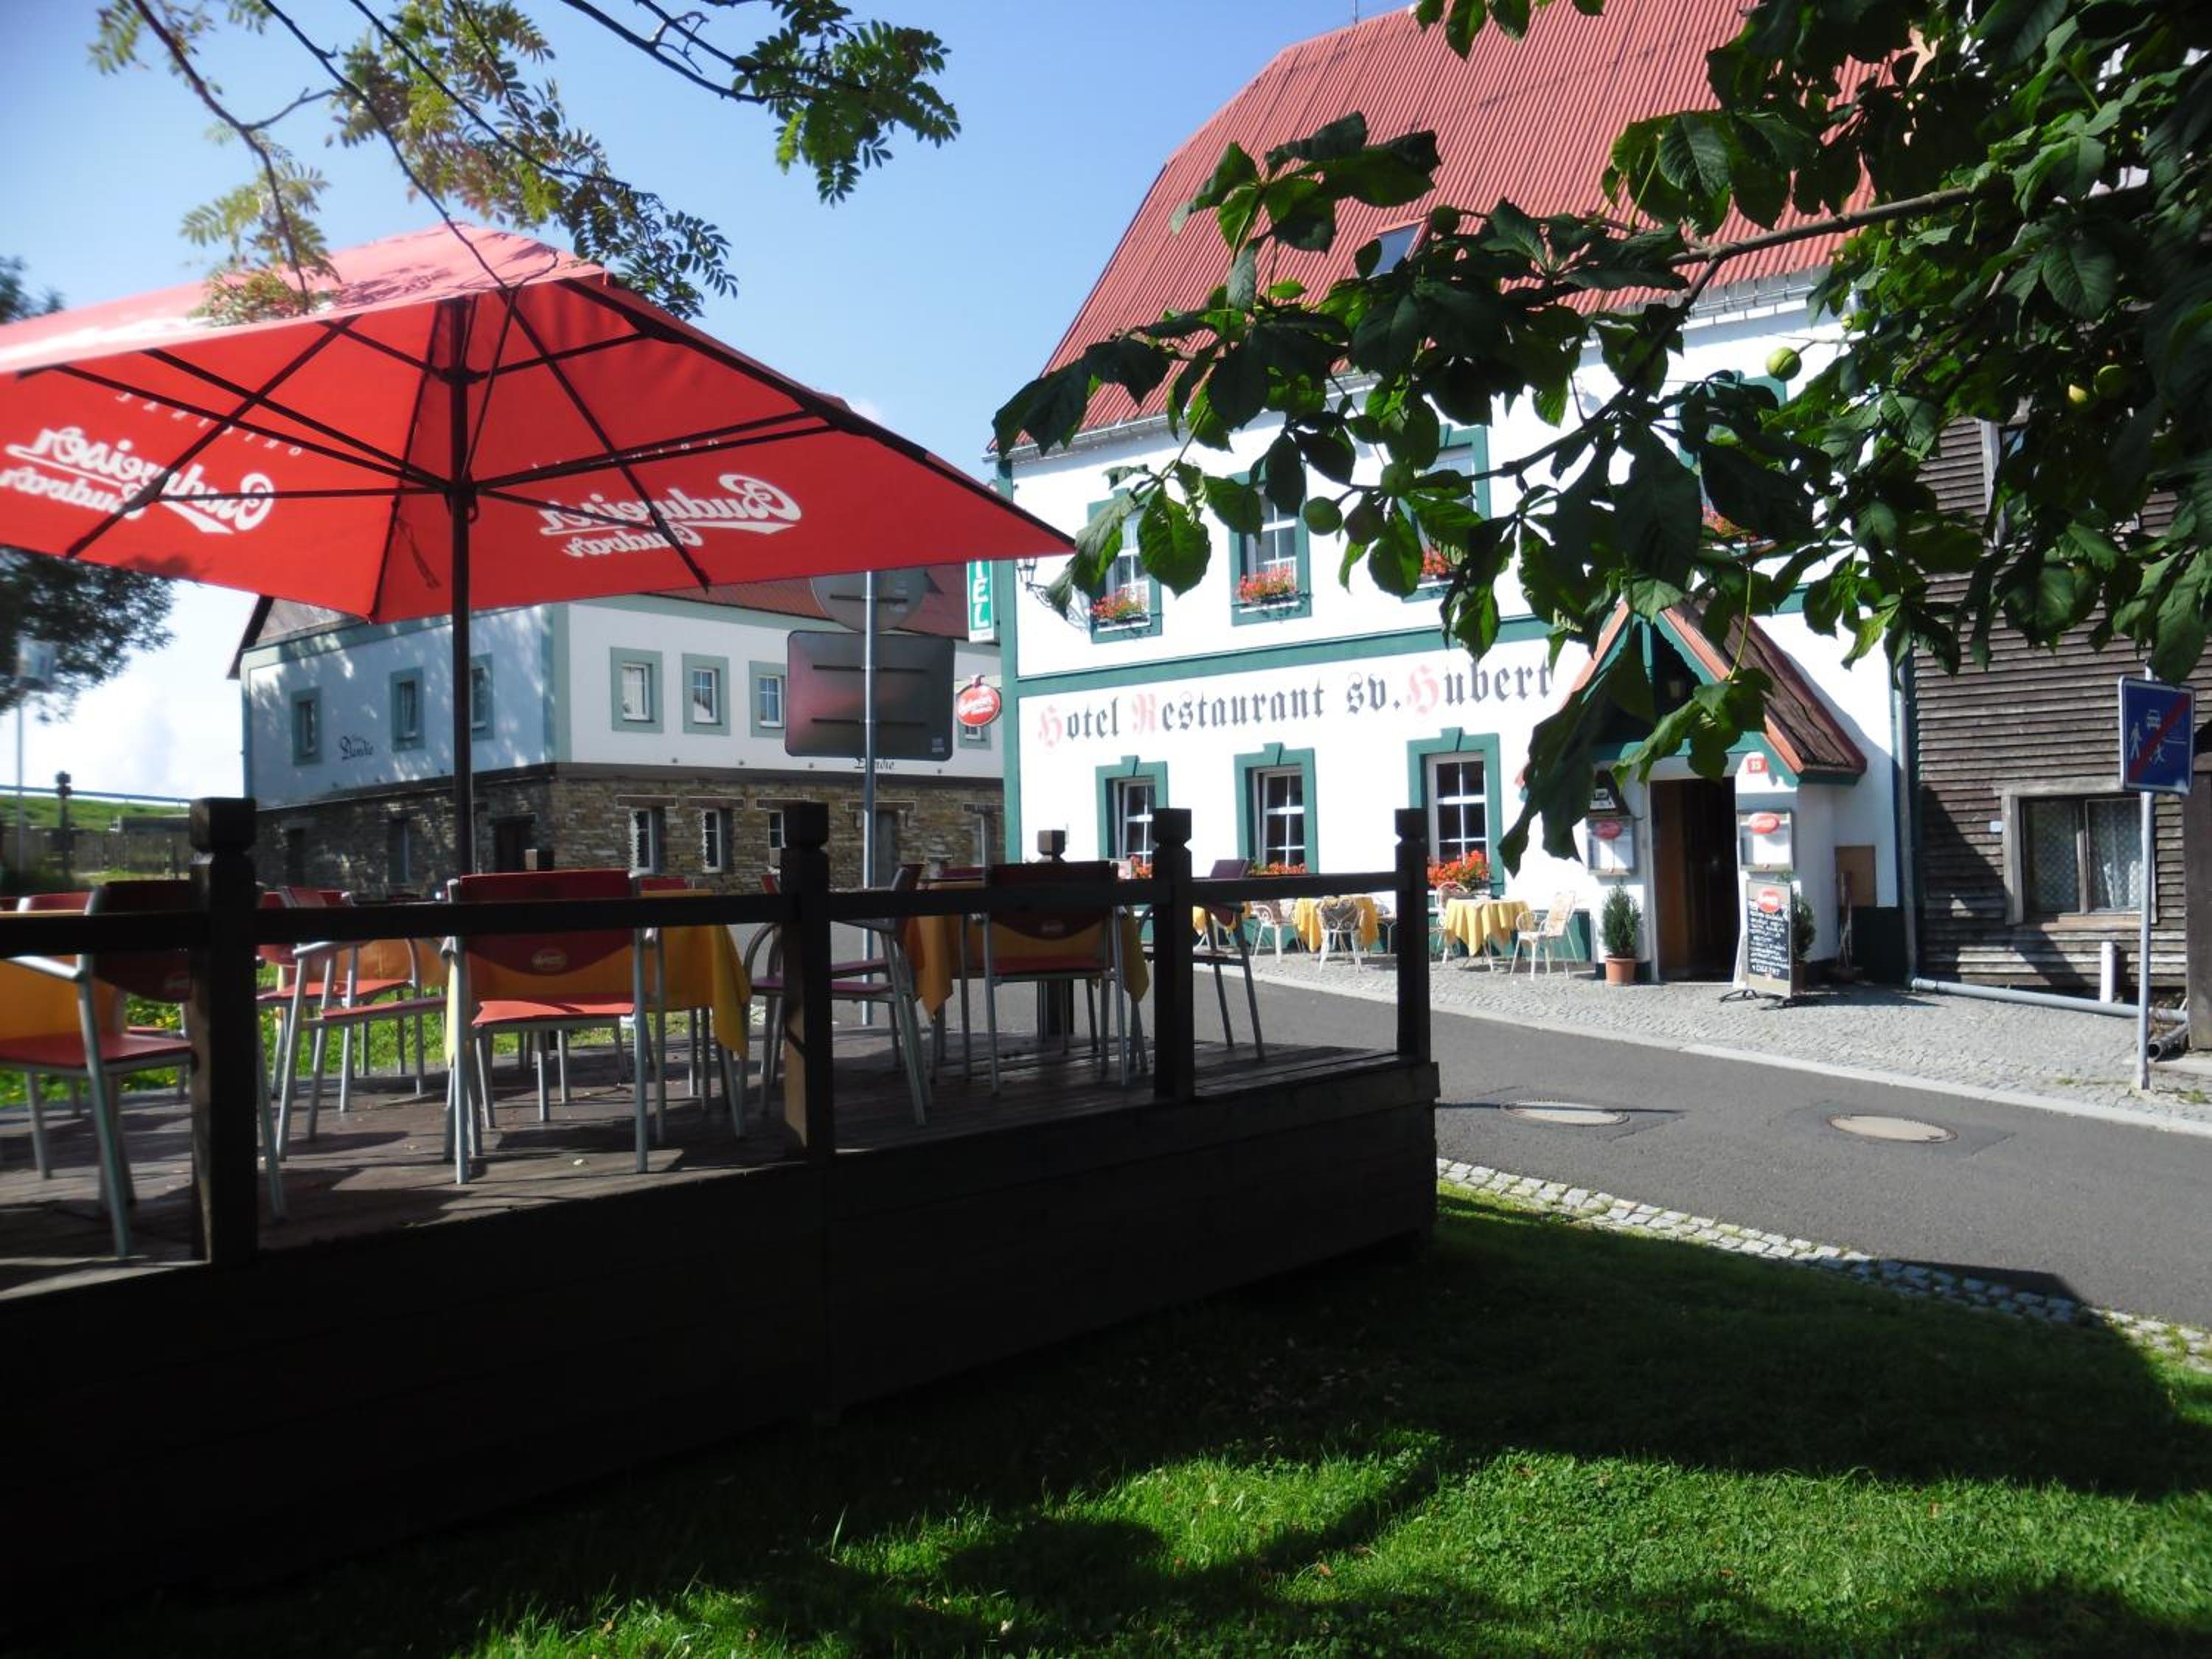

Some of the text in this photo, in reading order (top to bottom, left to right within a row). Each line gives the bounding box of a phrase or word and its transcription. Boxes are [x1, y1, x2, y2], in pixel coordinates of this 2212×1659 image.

[1038, 697, 1119, 748] Hotel
[1131, 678, 1324, 734] Restaurant
[1346, 671, 1400, 714] sv.
[1406, 653, 1550, 715] Hubert
